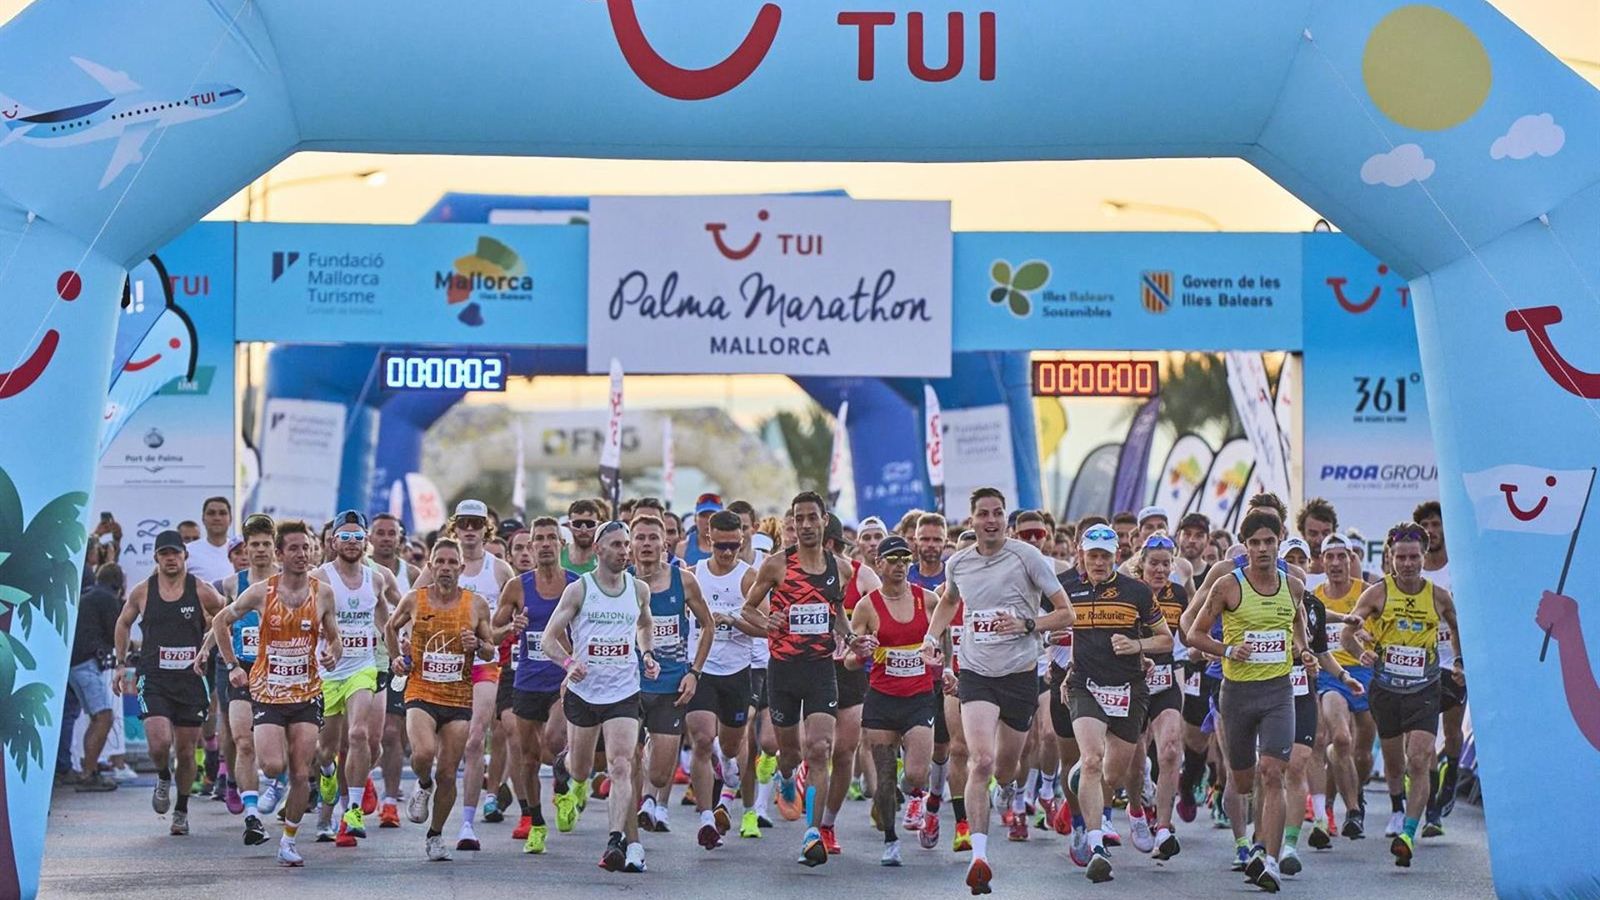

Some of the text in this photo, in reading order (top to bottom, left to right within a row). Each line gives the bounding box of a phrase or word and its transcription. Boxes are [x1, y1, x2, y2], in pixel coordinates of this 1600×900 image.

[837, 11, 997, 83] TUI
[190, 92, 217, 107] TUI
[777, 234, 824, 257] TUI
[308, 252, 384, 268] Fundació
[308, 271, 380, 286] Mallorca
[435, 271, 533, 291] Mallorca
[1182, 274, 1281, 290] Govern de les
[308, 288, 375, 303] Turisme
[608, 268, 932, 327] Palma Marathon
[1042, 291, 1115, 303] Illes Balears
[1182, 293, 1274, 308] Illes Balears
[1042, 306, 1113, 319] Sostenibles
[709, 336, 831, 356] MALLORCA
[125, 454, 183, 462] Port de Palma
[795, 614, 825, 624] 1216
[978, 620, 1001, 632] 272
[343, 637, 364, 647] 013
[164, 651, 191, 660] 6709
[593, 645, 624, 657] 5821
[891, 657, 921, 668] 5058
[1391, 654, 1419, 666] 6642
[273, 665, 303, 676] 4816
[428, 662, 458, 673] 5850
